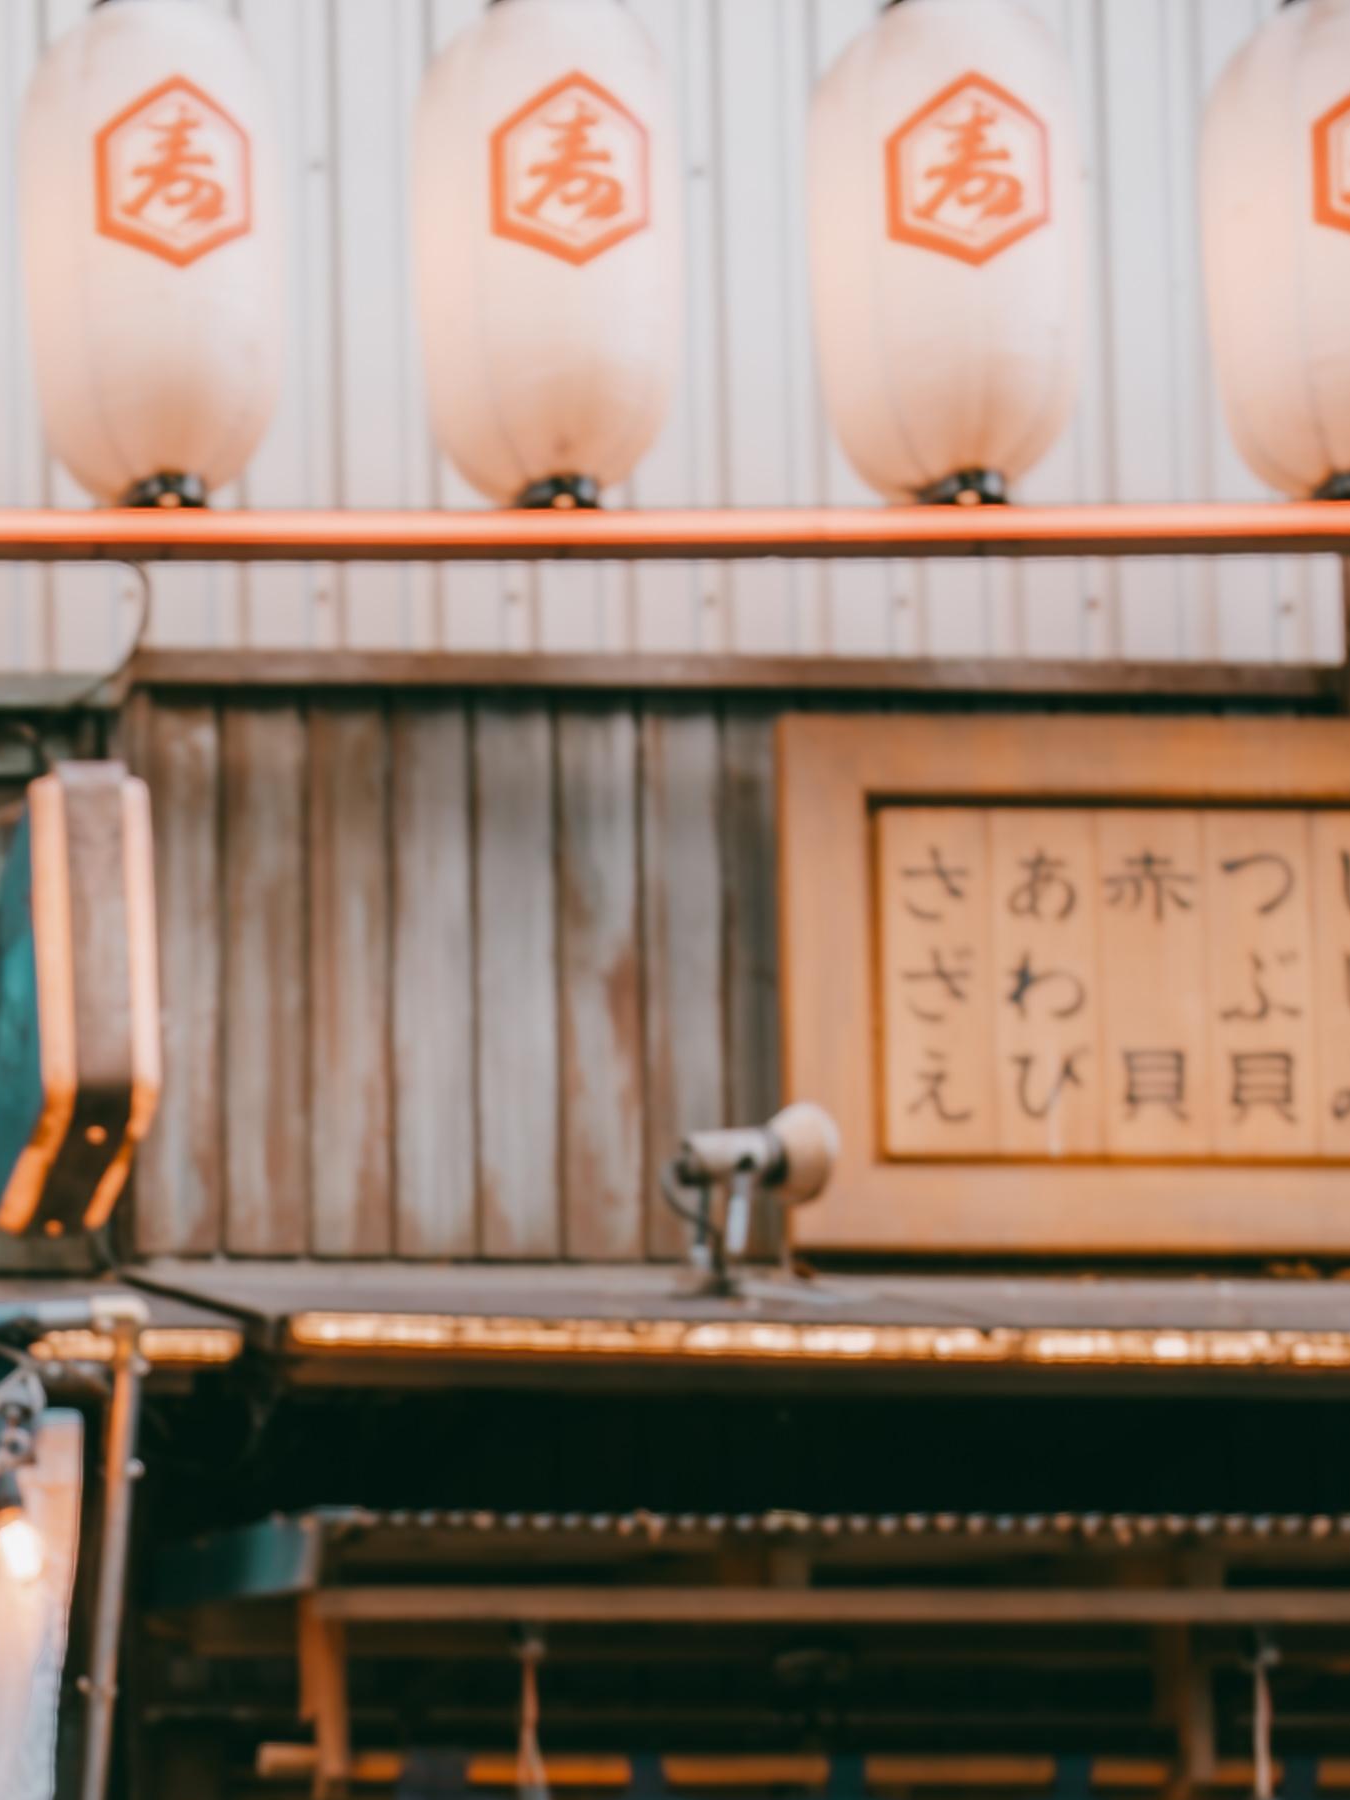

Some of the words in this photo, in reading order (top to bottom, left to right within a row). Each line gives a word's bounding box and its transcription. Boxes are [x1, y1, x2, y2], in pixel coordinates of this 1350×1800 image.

[901, 846, 975, 1126] さざえ
[1005, 846, 1091, 1122] あわび
[1101, 848, 1197, 1124] 赤貝
[1218, 852, 1303, 1124] つぶ貝
